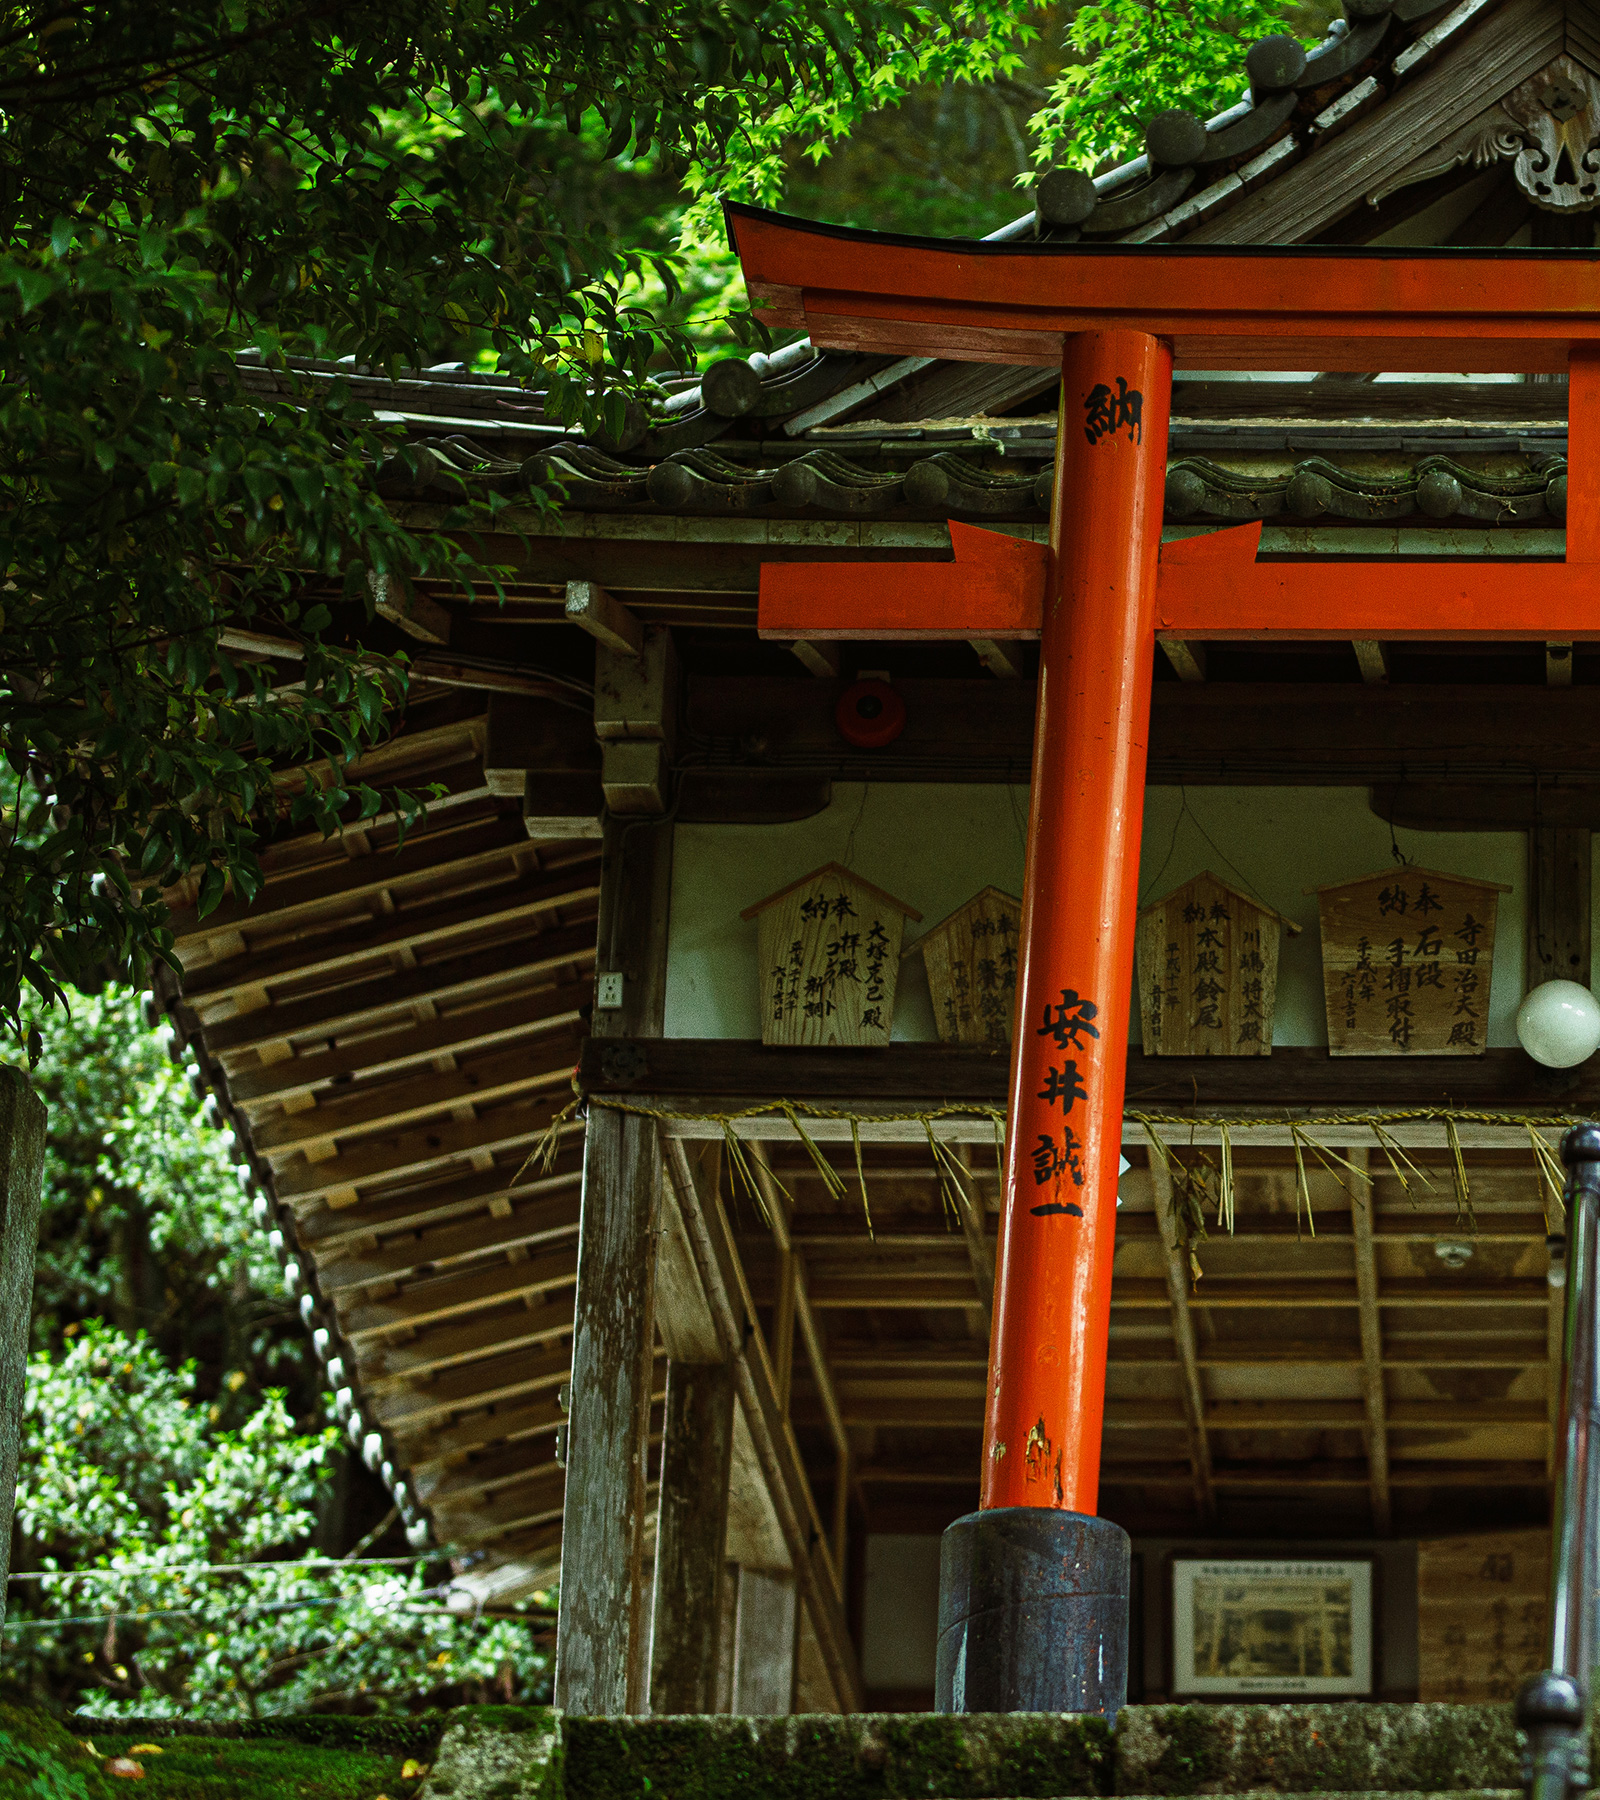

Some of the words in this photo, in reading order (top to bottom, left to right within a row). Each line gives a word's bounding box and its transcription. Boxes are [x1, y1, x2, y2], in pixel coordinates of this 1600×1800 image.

[1084, 376, 1144, 446] 納
[801, 893, 858, 925] 奉納
[1182, 901, 1231, 924] 奉納
[1378, 882, 1444, 916] 奉納
[837, 930, 862, 983] 拝殿
[1357, 936, 1377, 1002] 平成九年
[1413, 925, 1445, 990] 石段
[1340, 972, 1357, 1029] 六月吉日
